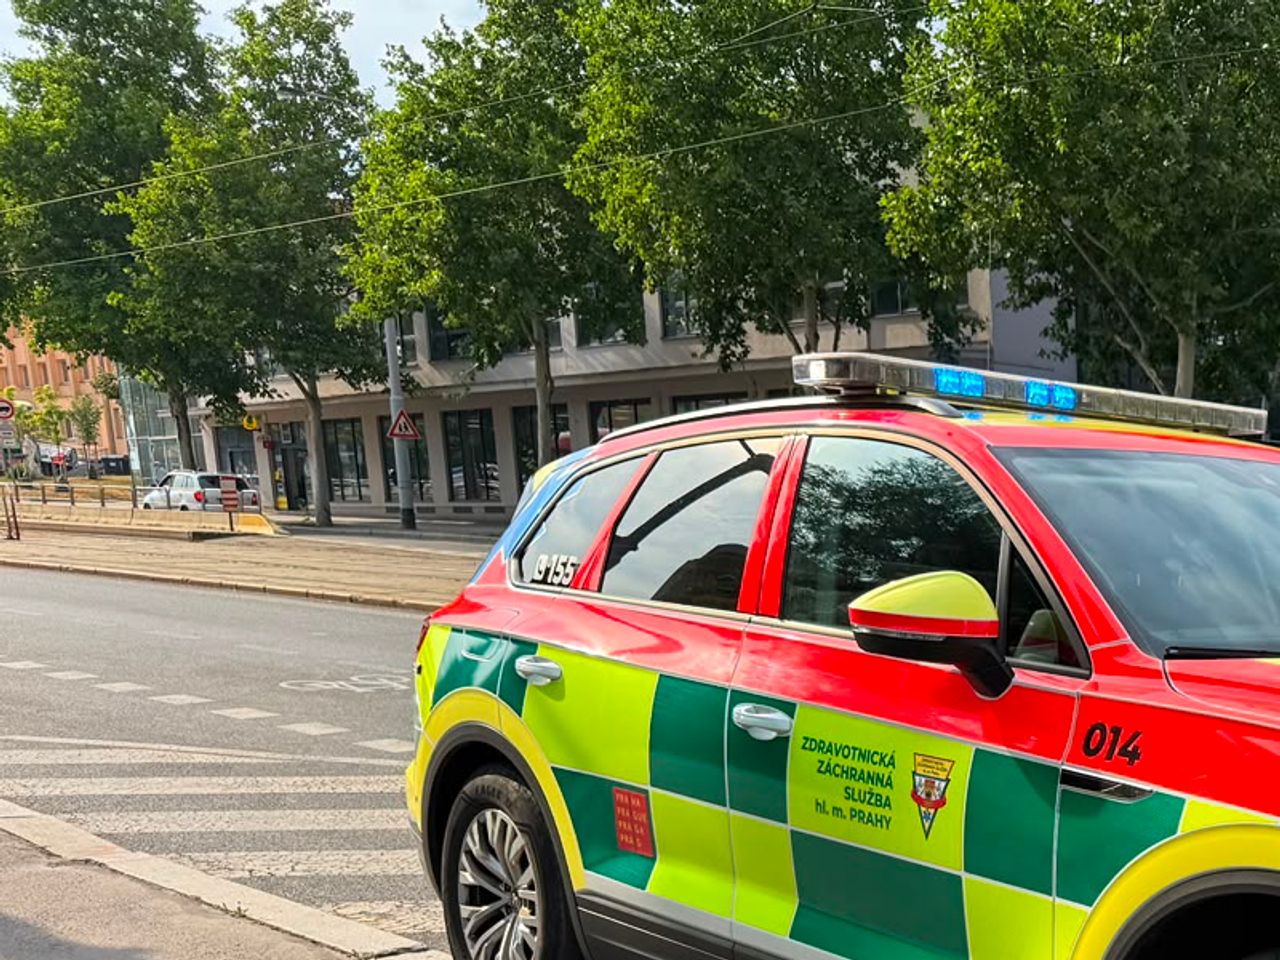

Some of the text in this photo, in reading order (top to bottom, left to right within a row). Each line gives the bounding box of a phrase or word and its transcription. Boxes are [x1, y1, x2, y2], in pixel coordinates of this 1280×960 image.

[801, 735, 897, 769] ZDRAVOTNICKÁ
[1082, 722, 1143, 767] 014
[817, 758, 894, 790] ZÁCHRANNÁ
[815, 798, 893, 831] hl. m. PRAHY
[844, 785, 893, 811] SLUŽBA
